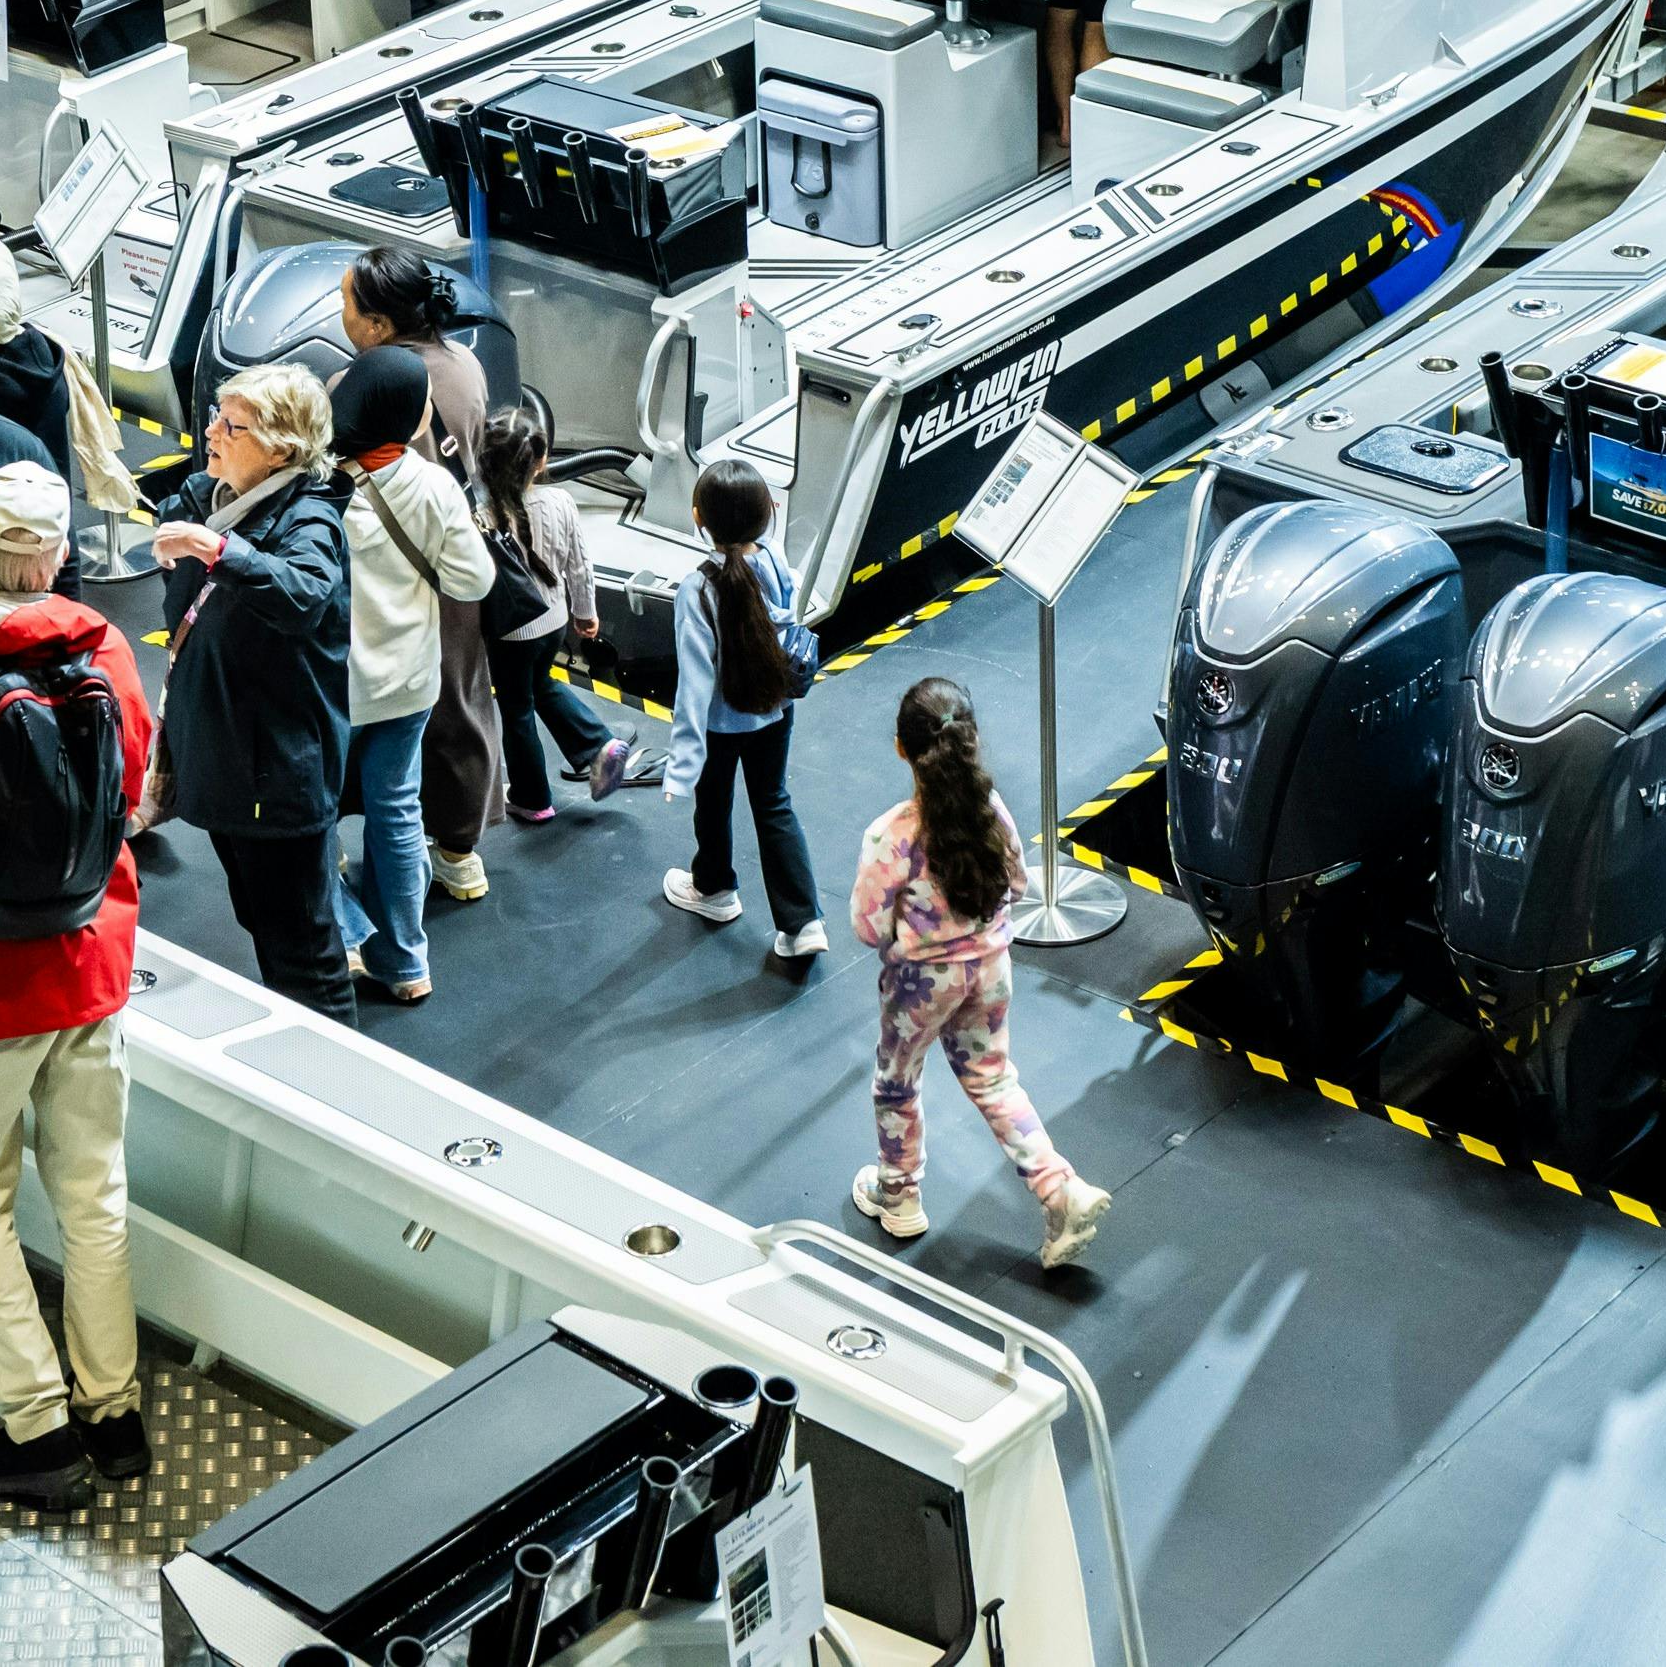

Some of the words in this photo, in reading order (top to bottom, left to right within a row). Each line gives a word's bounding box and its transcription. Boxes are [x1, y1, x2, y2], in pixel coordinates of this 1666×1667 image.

[121, 247, 144, 261] Please
[145, 253, 168, 267] remov
[123, 262, 139, 272] your
[141, 265, 162, 278] shoes.
[910, 276, 926, 286] 10
[890, 287, 907, 297] 20
[962, 314, 1055, 371] www.huntsmarine.com.au
[899, 339, 1061, 468] YELLOWFIN
[1612, 488, 1643, 511] SAVE
